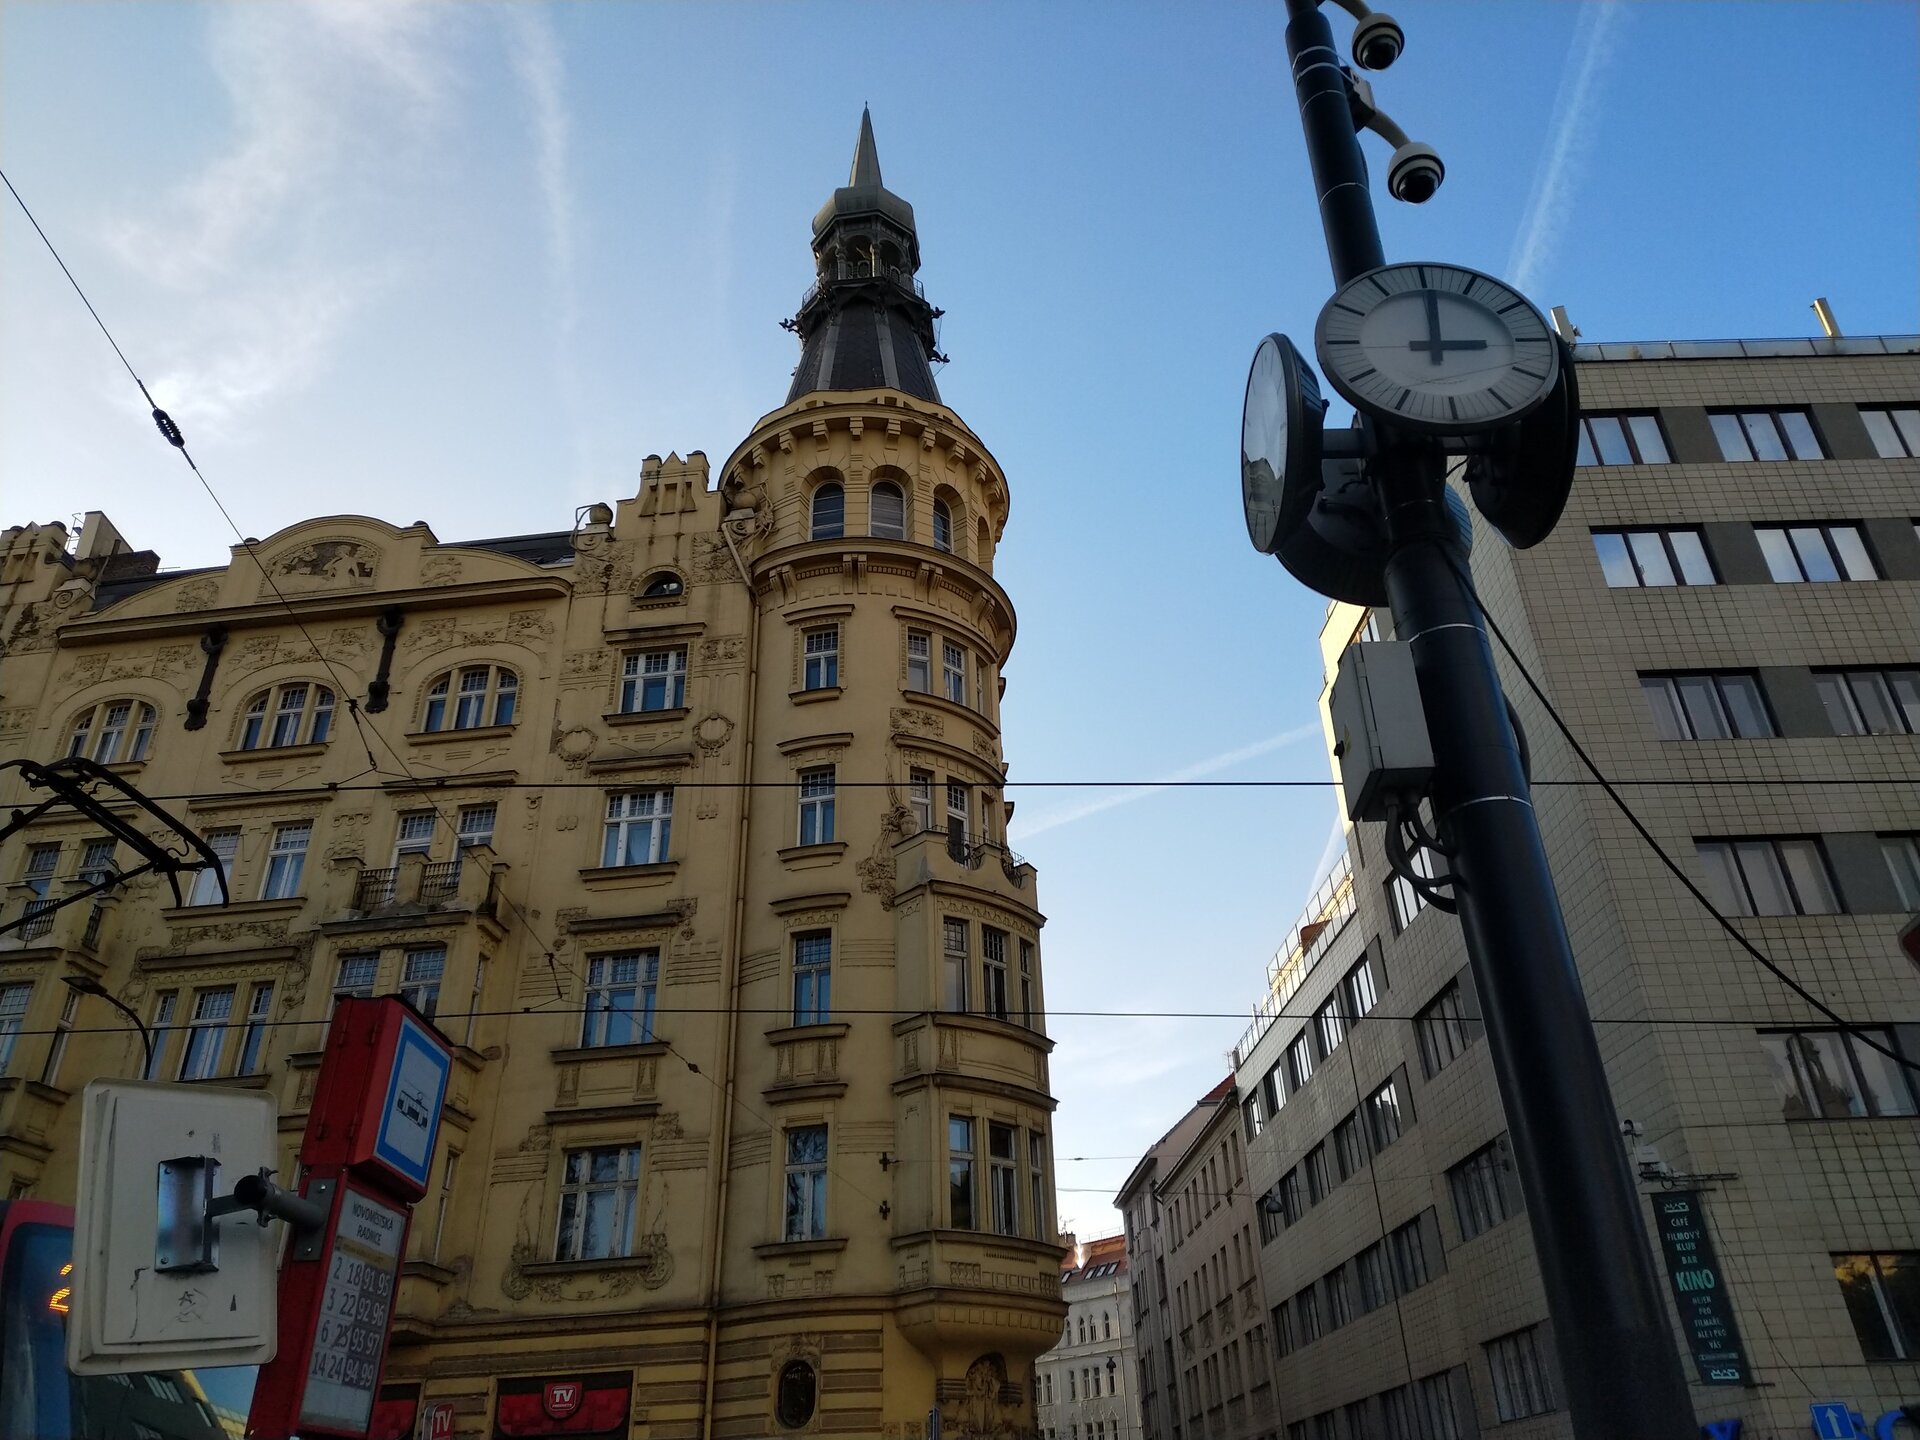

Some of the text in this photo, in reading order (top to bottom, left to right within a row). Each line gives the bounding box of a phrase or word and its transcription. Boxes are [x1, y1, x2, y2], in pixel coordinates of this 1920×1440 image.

[1671, 1216, 1688, 1226] CAFÉ
[1666, 1229, 1700, 1241] FILMOVÝ
[1675, 1242, 1696, 1251] KLUB
[1681, 1255, 1698, 1264] BAR
[333, 1257, 390, 1296] 2 18 91 95
[1675, 1269, 1715, 1291] KINO
[327, 1288, 385, 1326] 3 22 92 96
[321, 1320, 330, 1343] 6
[351, 1328, 365, 1351] 93
[366, 1332, 380, 1356] 97
[312, 1352, 374, 1387] 14 24 94 99
[553, 1389, 574, 1402] TV
[435, 1409, 453, 1434] TV
